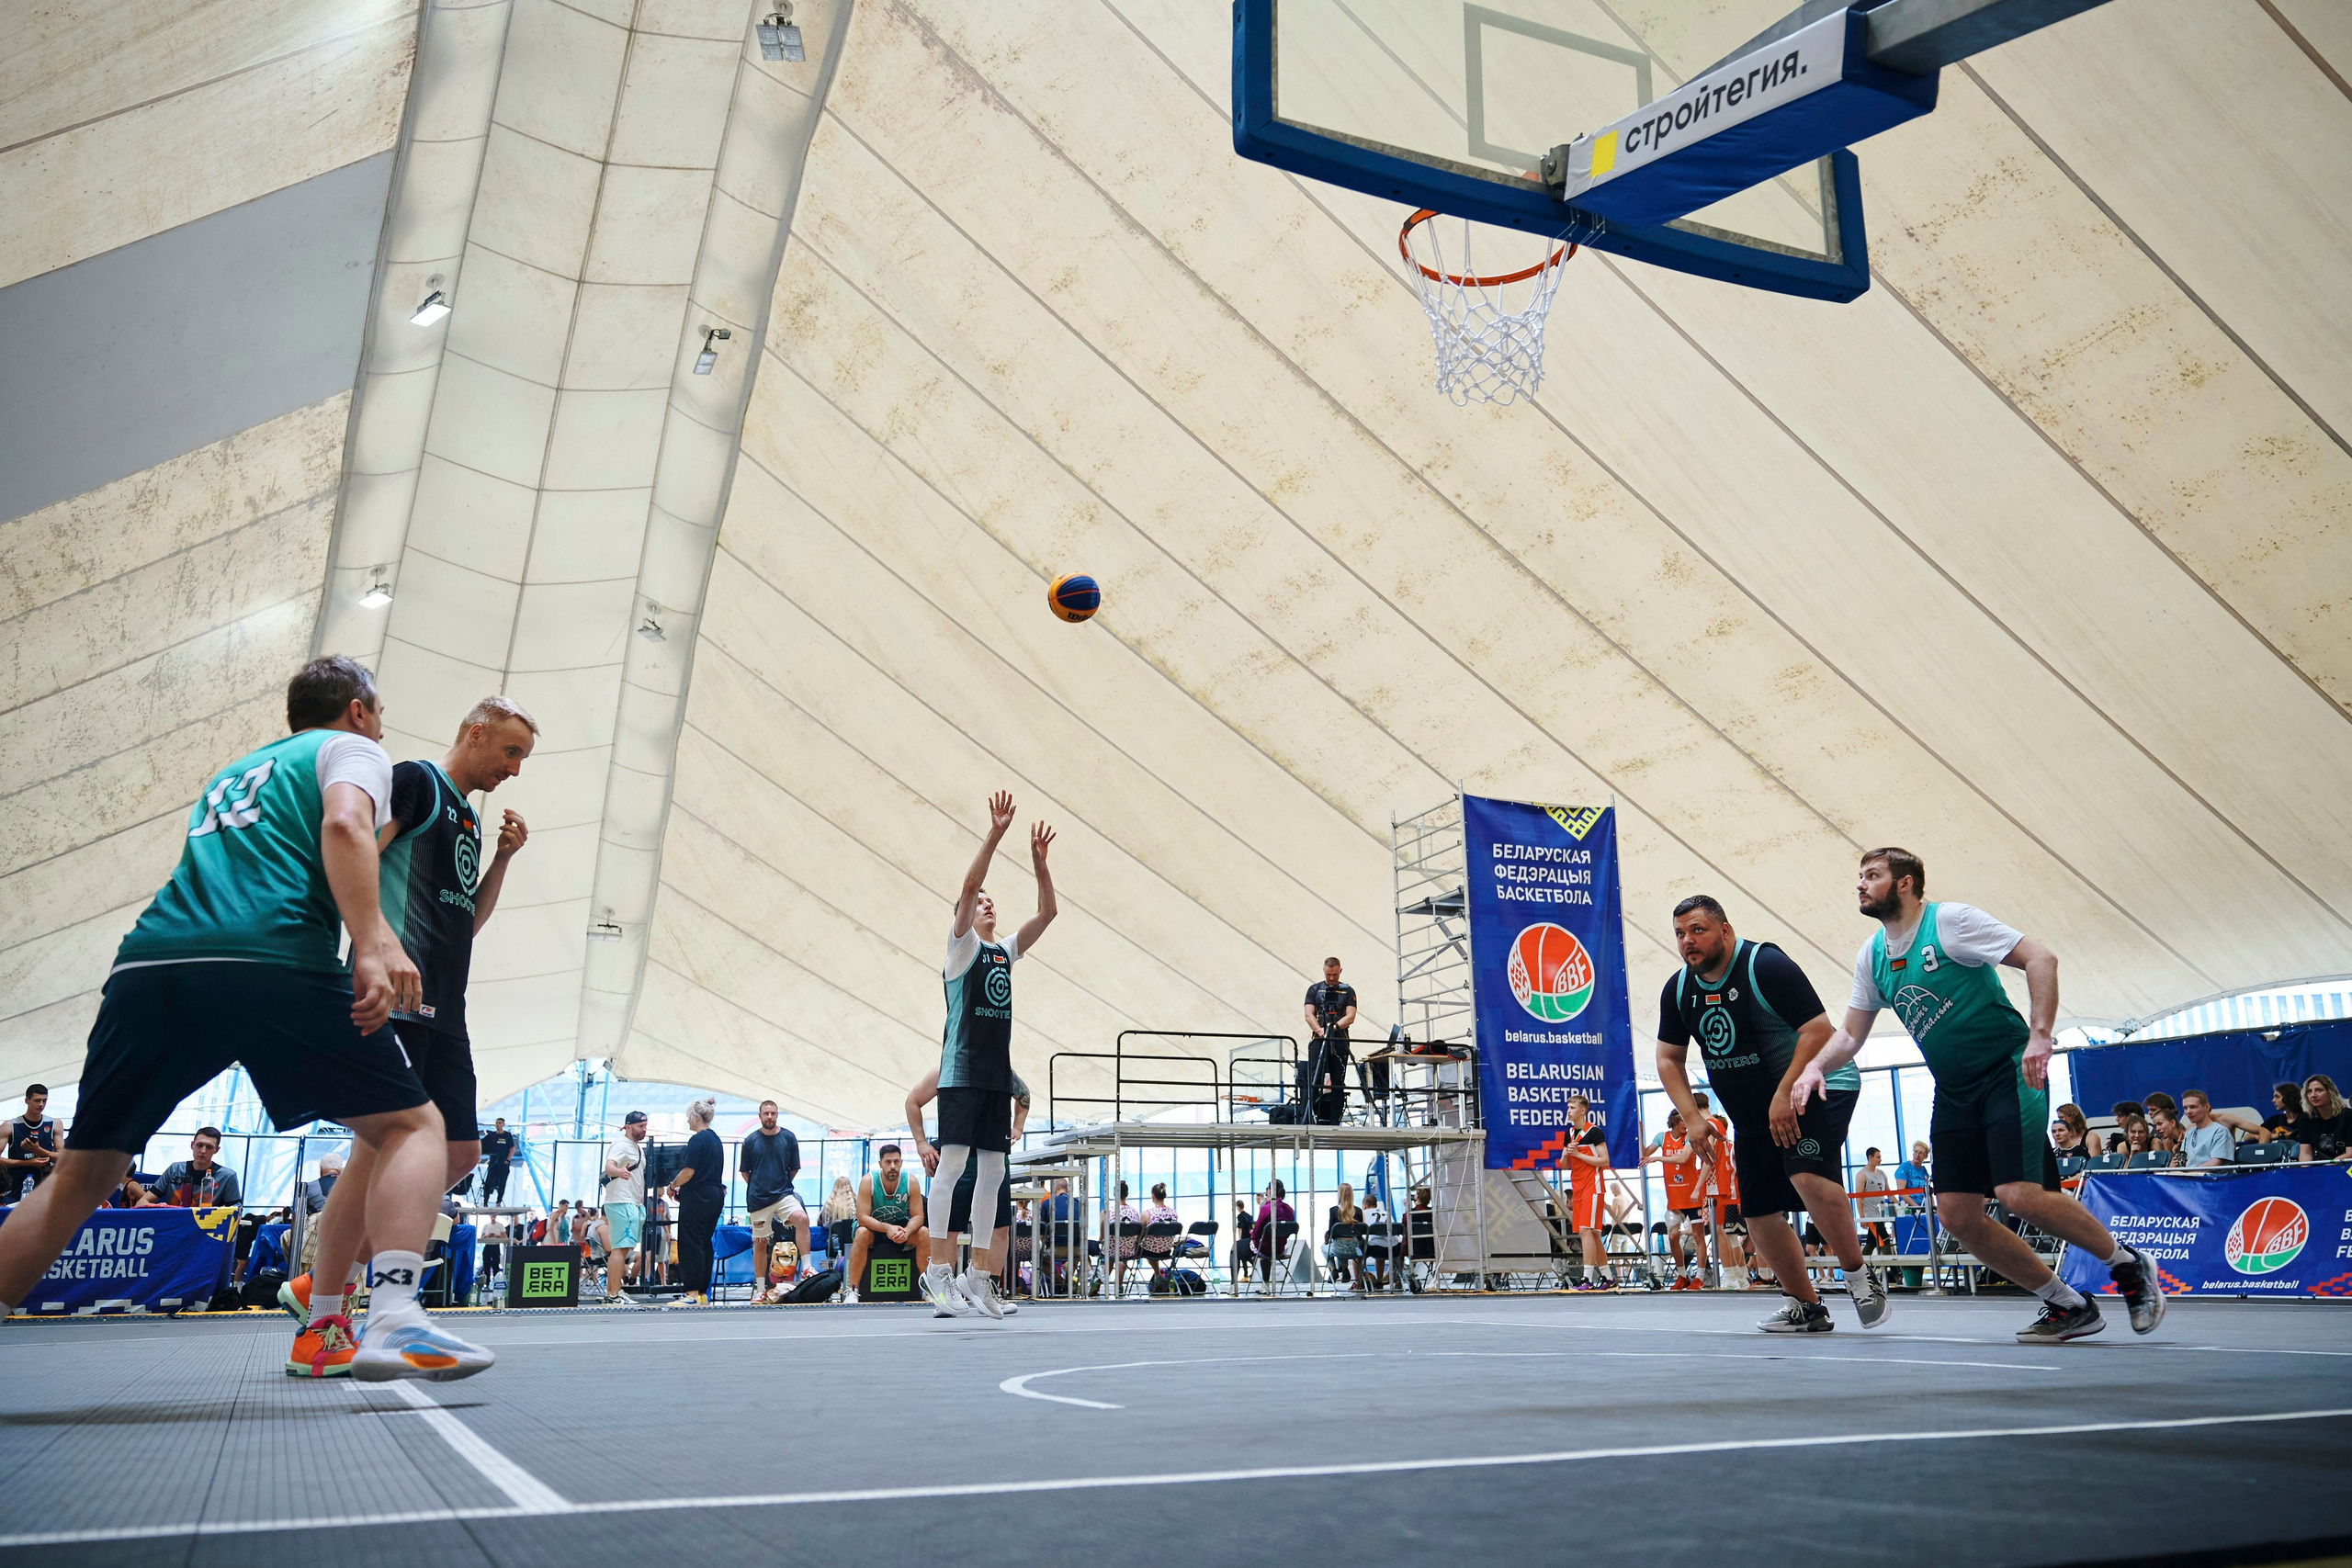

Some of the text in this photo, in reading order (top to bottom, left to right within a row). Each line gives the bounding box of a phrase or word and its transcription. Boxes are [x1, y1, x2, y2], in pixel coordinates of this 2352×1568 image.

[1624, 50, 1808, 153] стройтегия.
[447, 805, 458, 824] 22
[1492, 843, 1591, 864] БЕЛАРУСКАЯ
[1494, 863, 1591, 886] ФЕДЭРАЦЫЯ
[1496, 885, 1593, 906] БАСКЕТБОЛА
[1920, 944, 1939, 973] 3
[1557, 951, 1587, 993] BBF
[975, 1006, 1011, 1020] SHOOTE
[1505, 1029, 1602, 1044] belarus.basketball
[1704, 1053, 1760, 1070] HOOTERS
[1506, 1063, 1604, 1081] BELARUSIAN
[1510, 1109, 1607, 1127] FEDERAON
[895, 1193, 908, 1204] 34
[2109, 1215, 2200, 1229] БЕЛАРУСКАЯ
[2268, 1218, 2303, 1254] BBF
[42, 1257, 149, 1280] SKETBALL
[529, 1267, 565, 1280] BET
[876, 1263, 908, 1275] BET
[2201, 1280, 2300, 1290] belarus.basketball
